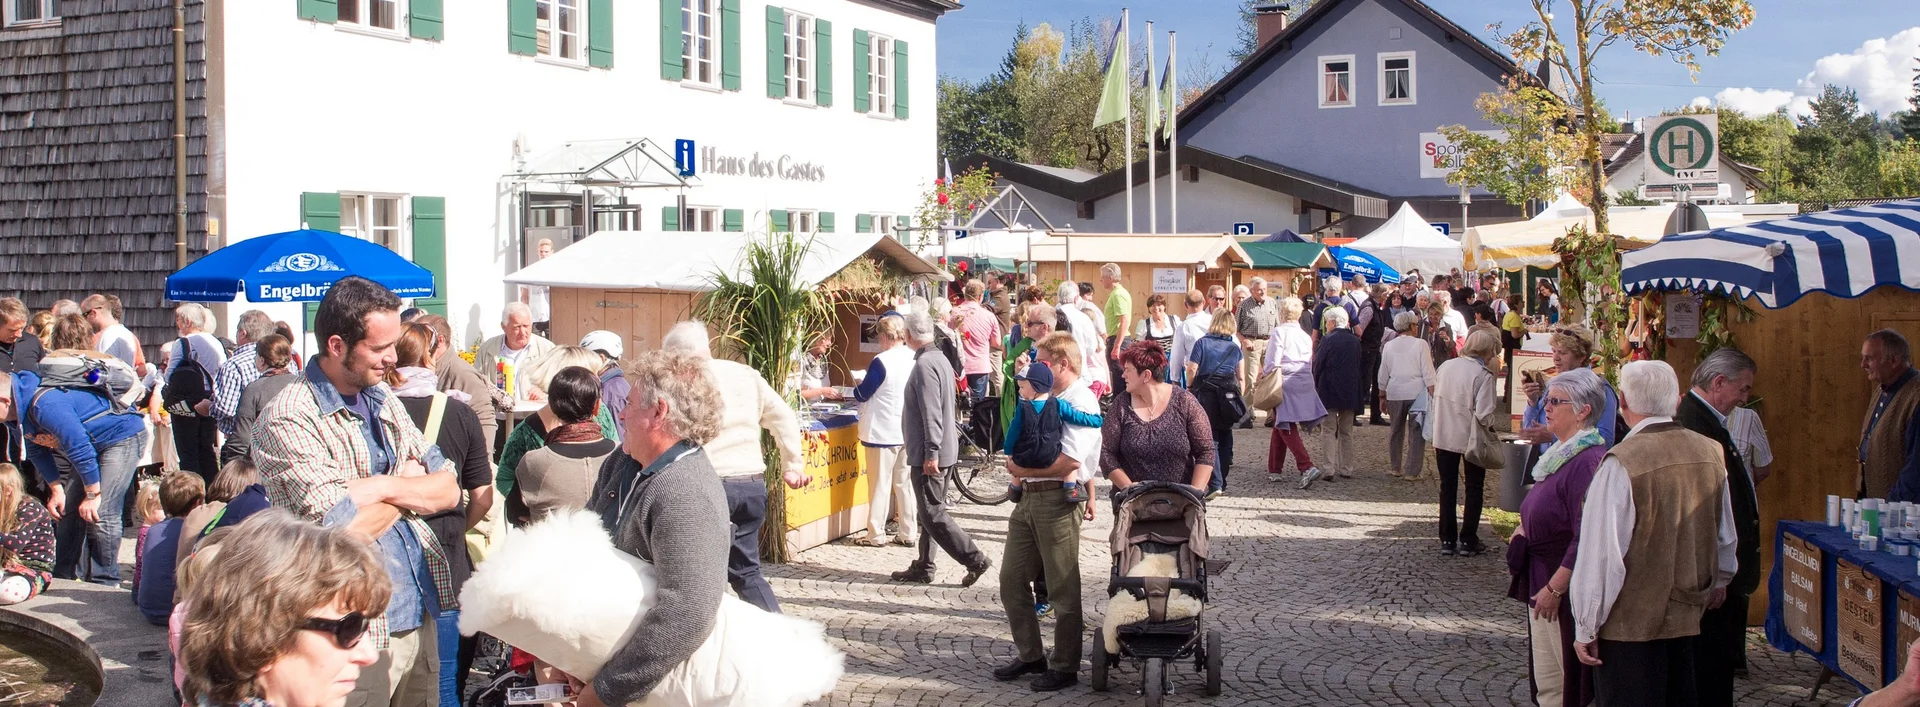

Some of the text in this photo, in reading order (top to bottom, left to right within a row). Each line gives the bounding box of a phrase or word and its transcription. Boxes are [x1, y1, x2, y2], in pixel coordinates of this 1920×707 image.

[1668, 130, 1694, 164] H
[701, 146, 825, 182] Haus des Gastes
[1671, 183, 1692, 192] RVA
[1343, 262, 1376, 275] Engelbräu
[260, 281, 331, 302] Engelbrä
[168, 408, 196, 417] adidas
[801, 442, 858, 469] AUSCHRING
[1791, 571, 1814, 594] BALSAM
[1796, 597, 1808, 614] Haut
[1844, 598, 1874, 625] BESTEN
[1841, 644, 1876, 676] Besondere
